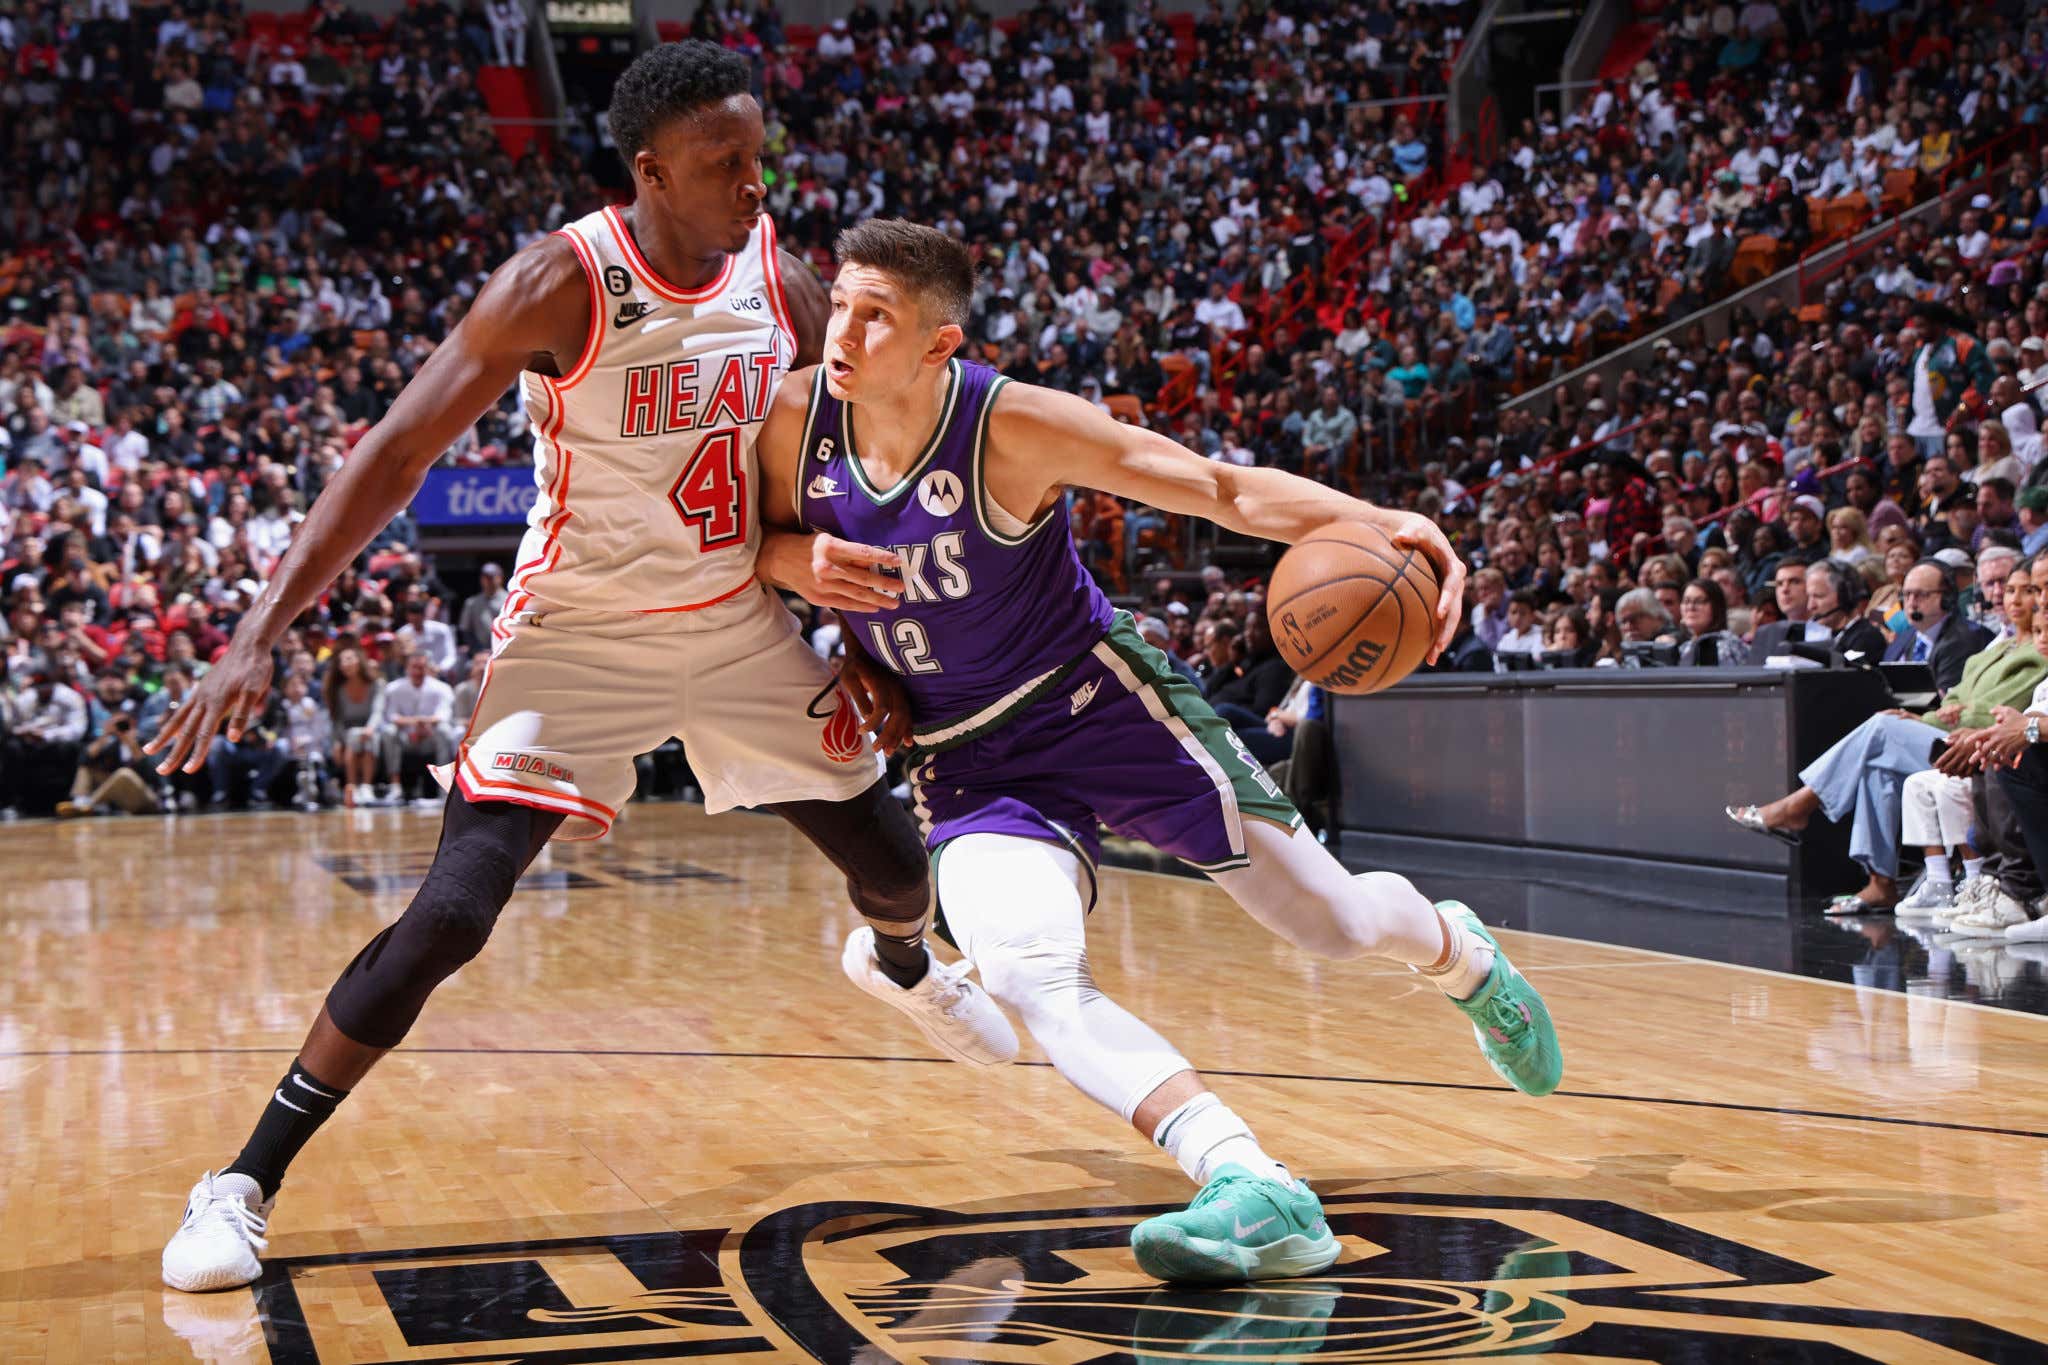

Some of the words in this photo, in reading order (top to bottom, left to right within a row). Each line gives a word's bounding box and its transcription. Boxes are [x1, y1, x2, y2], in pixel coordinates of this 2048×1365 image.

[608, 270, 626, 294] 6
[619, 302, 648, 317] NIKE
[621, 327, 780, 437] HEAT
[816, 438, 835, 462] 6
[667, 427, 746, 553] 4
[813, 474, 838, 493] NIKE
[868, 618, 944, 675] 12
[1070, 681, 1093, 708] NIKE
[492, 752, 574, 783] MIAMI
